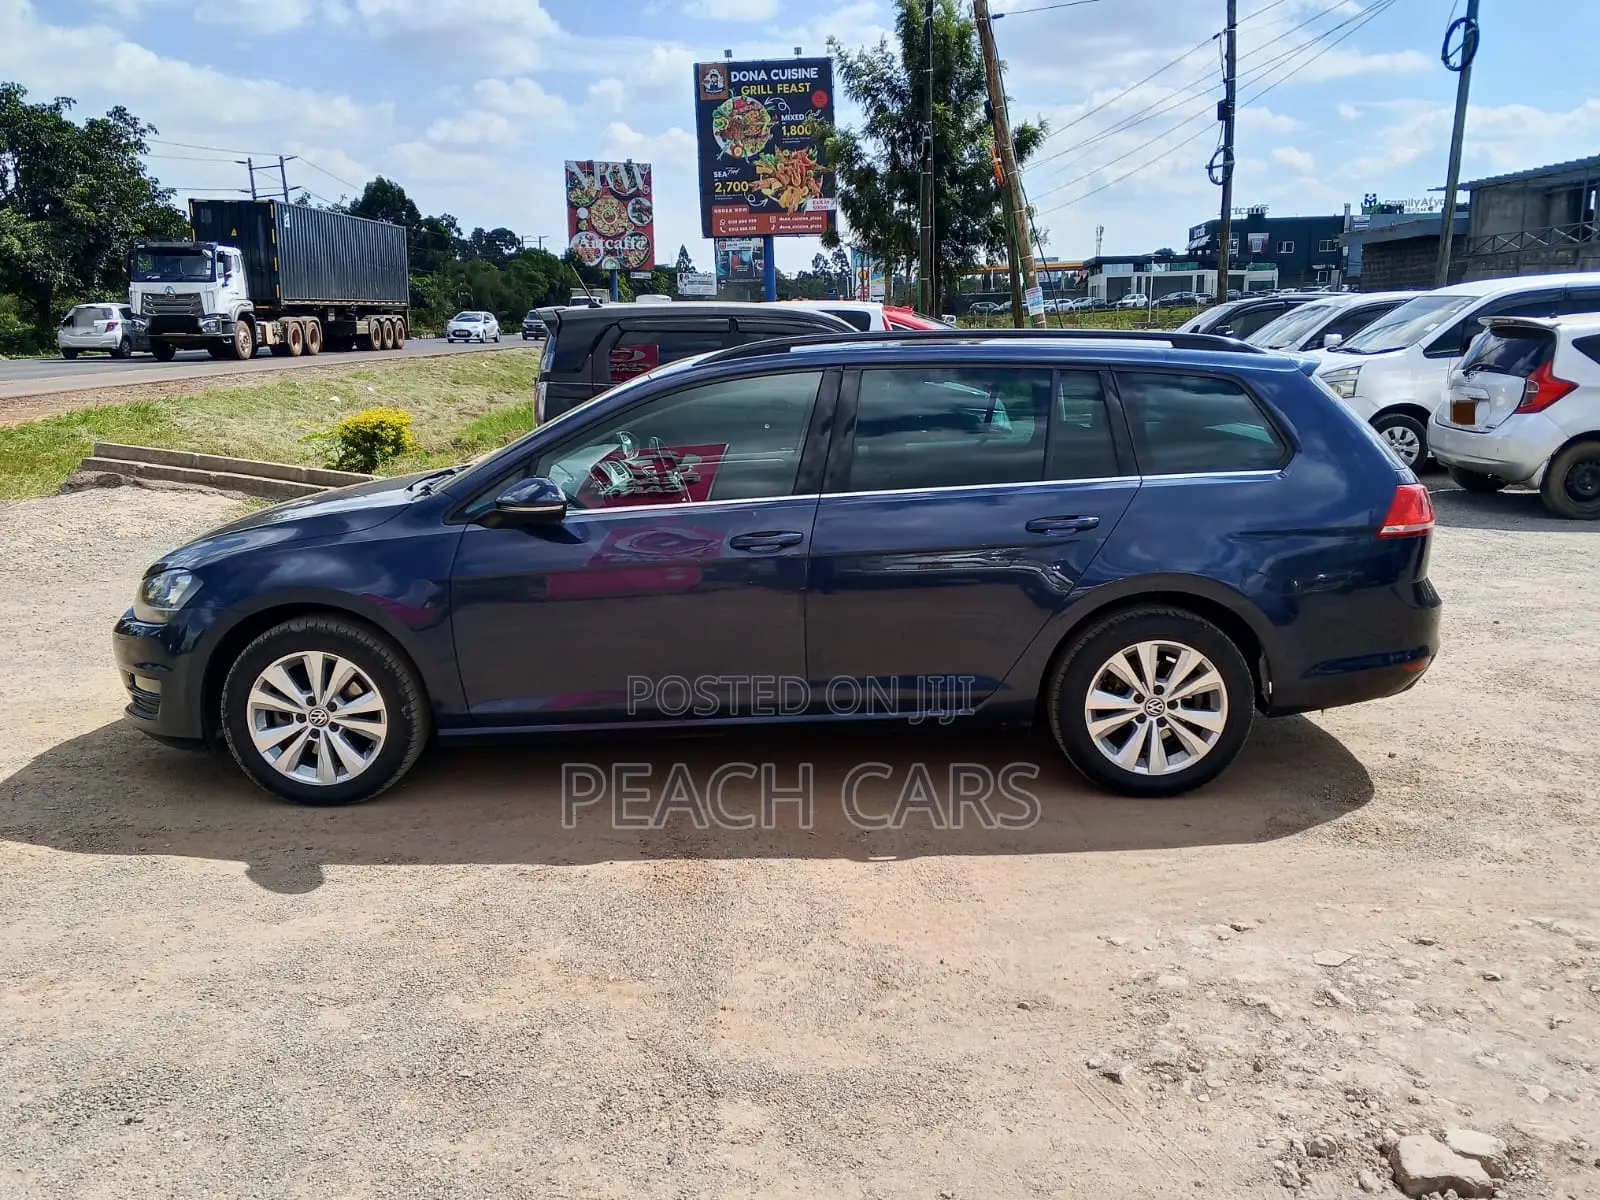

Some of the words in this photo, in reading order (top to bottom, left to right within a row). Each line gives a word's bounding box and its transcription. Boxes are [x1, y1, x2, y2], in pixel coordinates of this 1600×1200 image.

[731, 70, 767, 82] DONA
[770, 67, 819, 80] CUISINE
[741, 84, 773, 96] GRILL
[777, 82, 811, 94] FEAST
[781, 113, 805, 122] MIXED
[713, 170, 728, 178] SEA
[714, 180, 749, 196] 2,700
